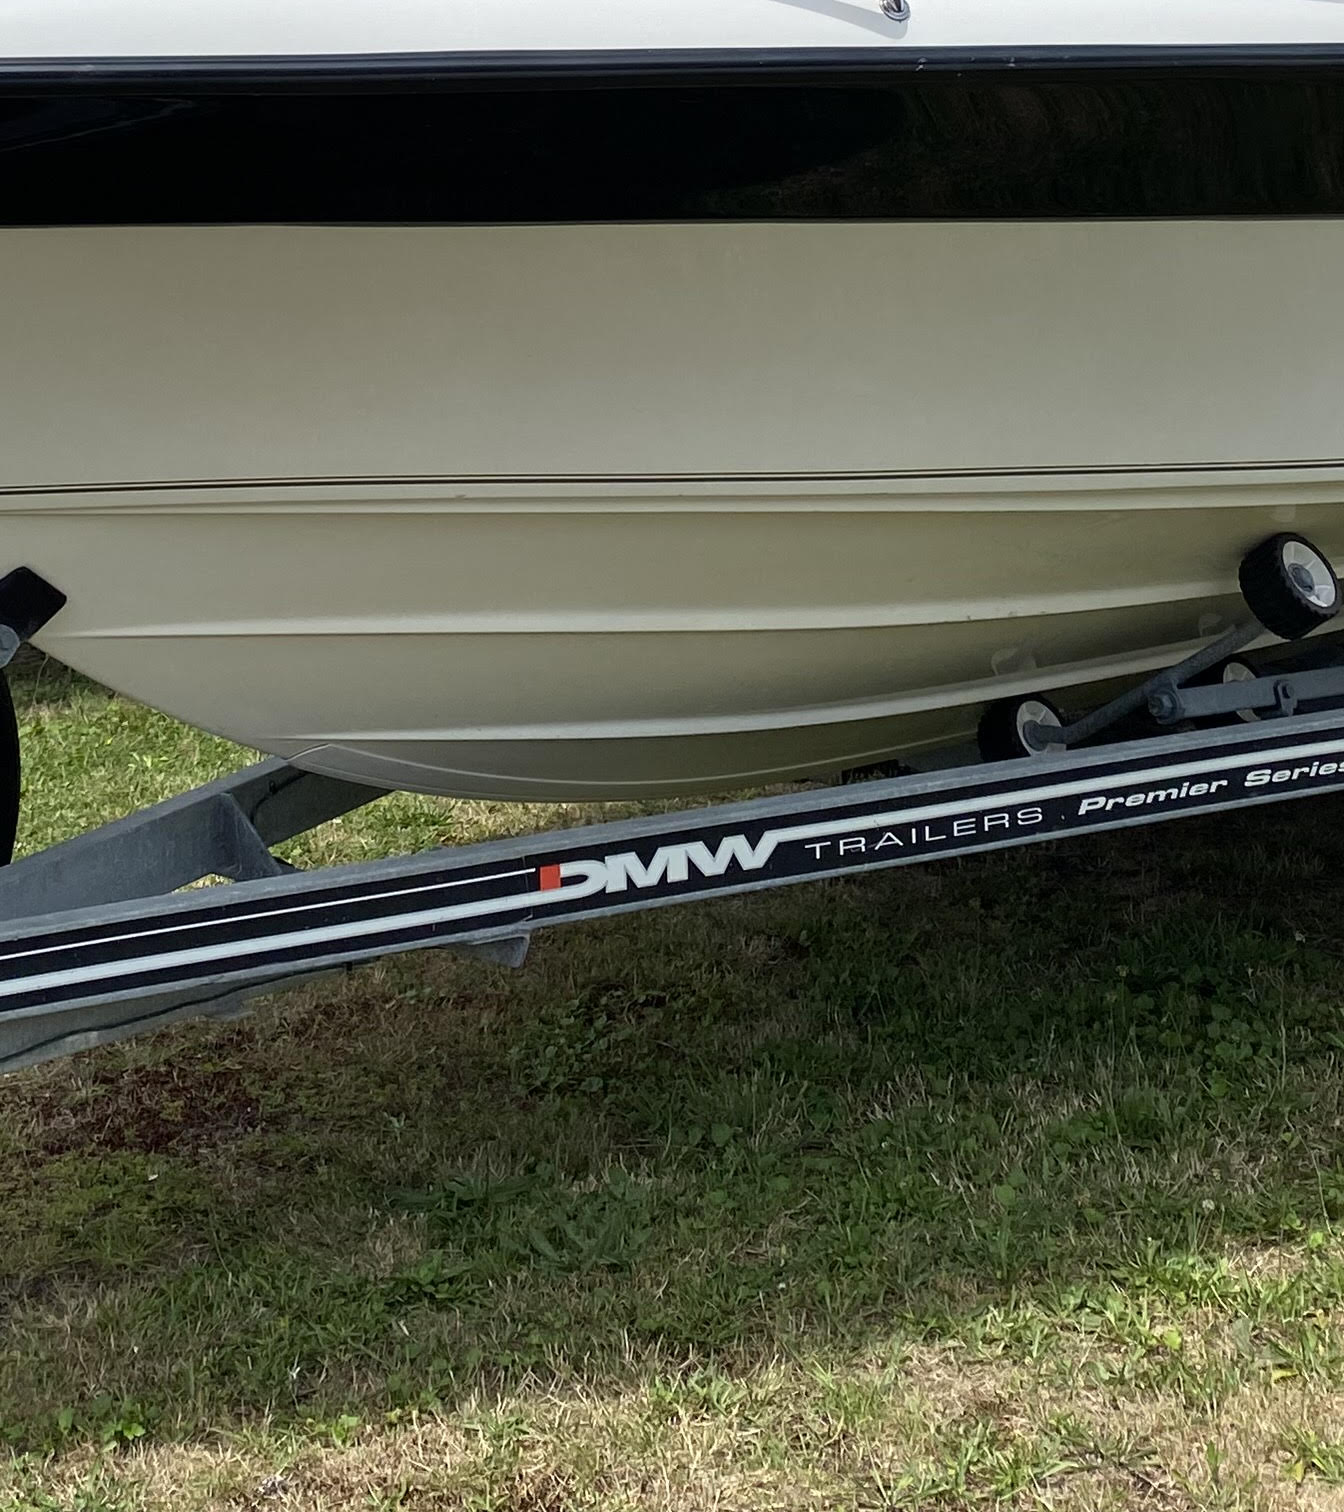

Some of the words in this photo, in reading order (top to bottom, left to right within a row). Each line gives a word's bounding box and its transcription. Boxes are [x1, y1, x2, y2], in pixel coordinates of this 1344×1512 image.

[540, 831, 778, 894] DMW
[805, 807, 1043, 860] TRAILERS
[1078, 779, 1228, 816] Premier
